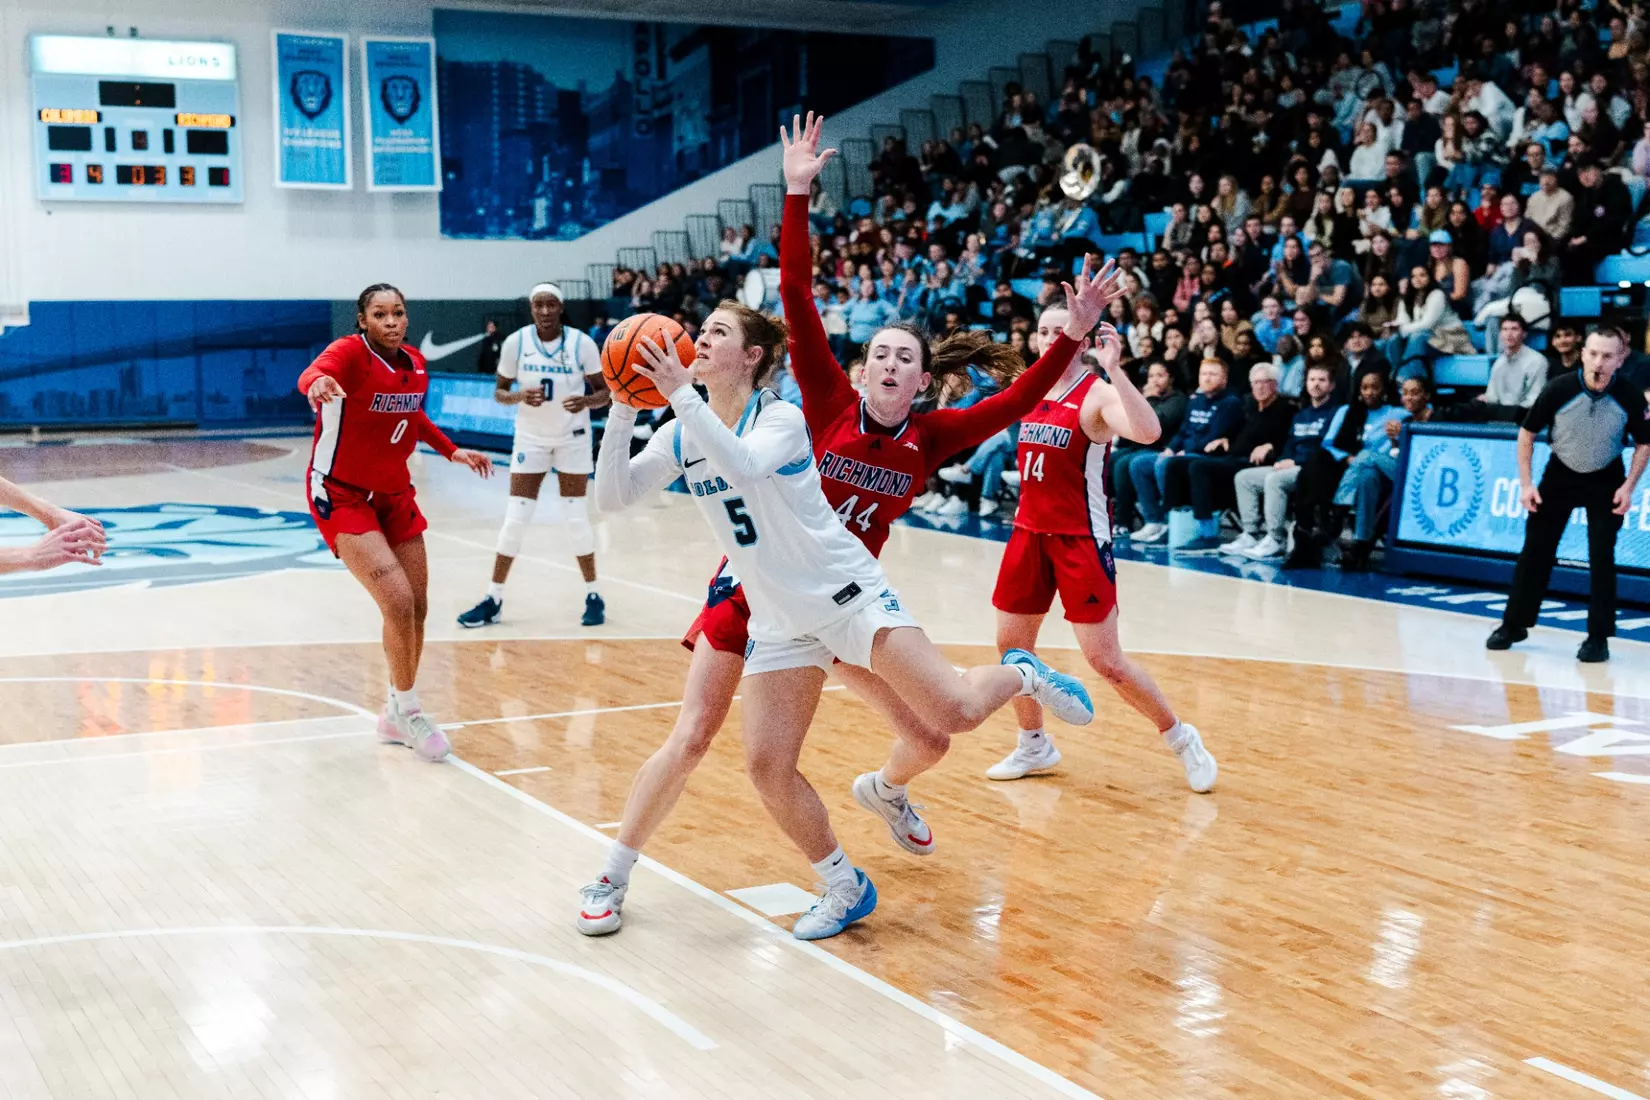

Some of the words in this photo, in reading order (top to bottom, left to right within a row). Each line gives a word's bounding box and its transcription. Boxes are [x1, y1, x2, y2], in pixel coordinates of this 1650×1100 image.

[168, 55, 221, 68] LIONS
[368, 392, 424, 413] RICHMO
[390, 419, 409, 444] 0
[818, 450, 913, 498] RICHMOND
[1023, 450, 1045, 482] 14
[1436, 466, 1460, 508] B
[722, 495, 759, 548] 5
[835, 494, 879, 532] 44
